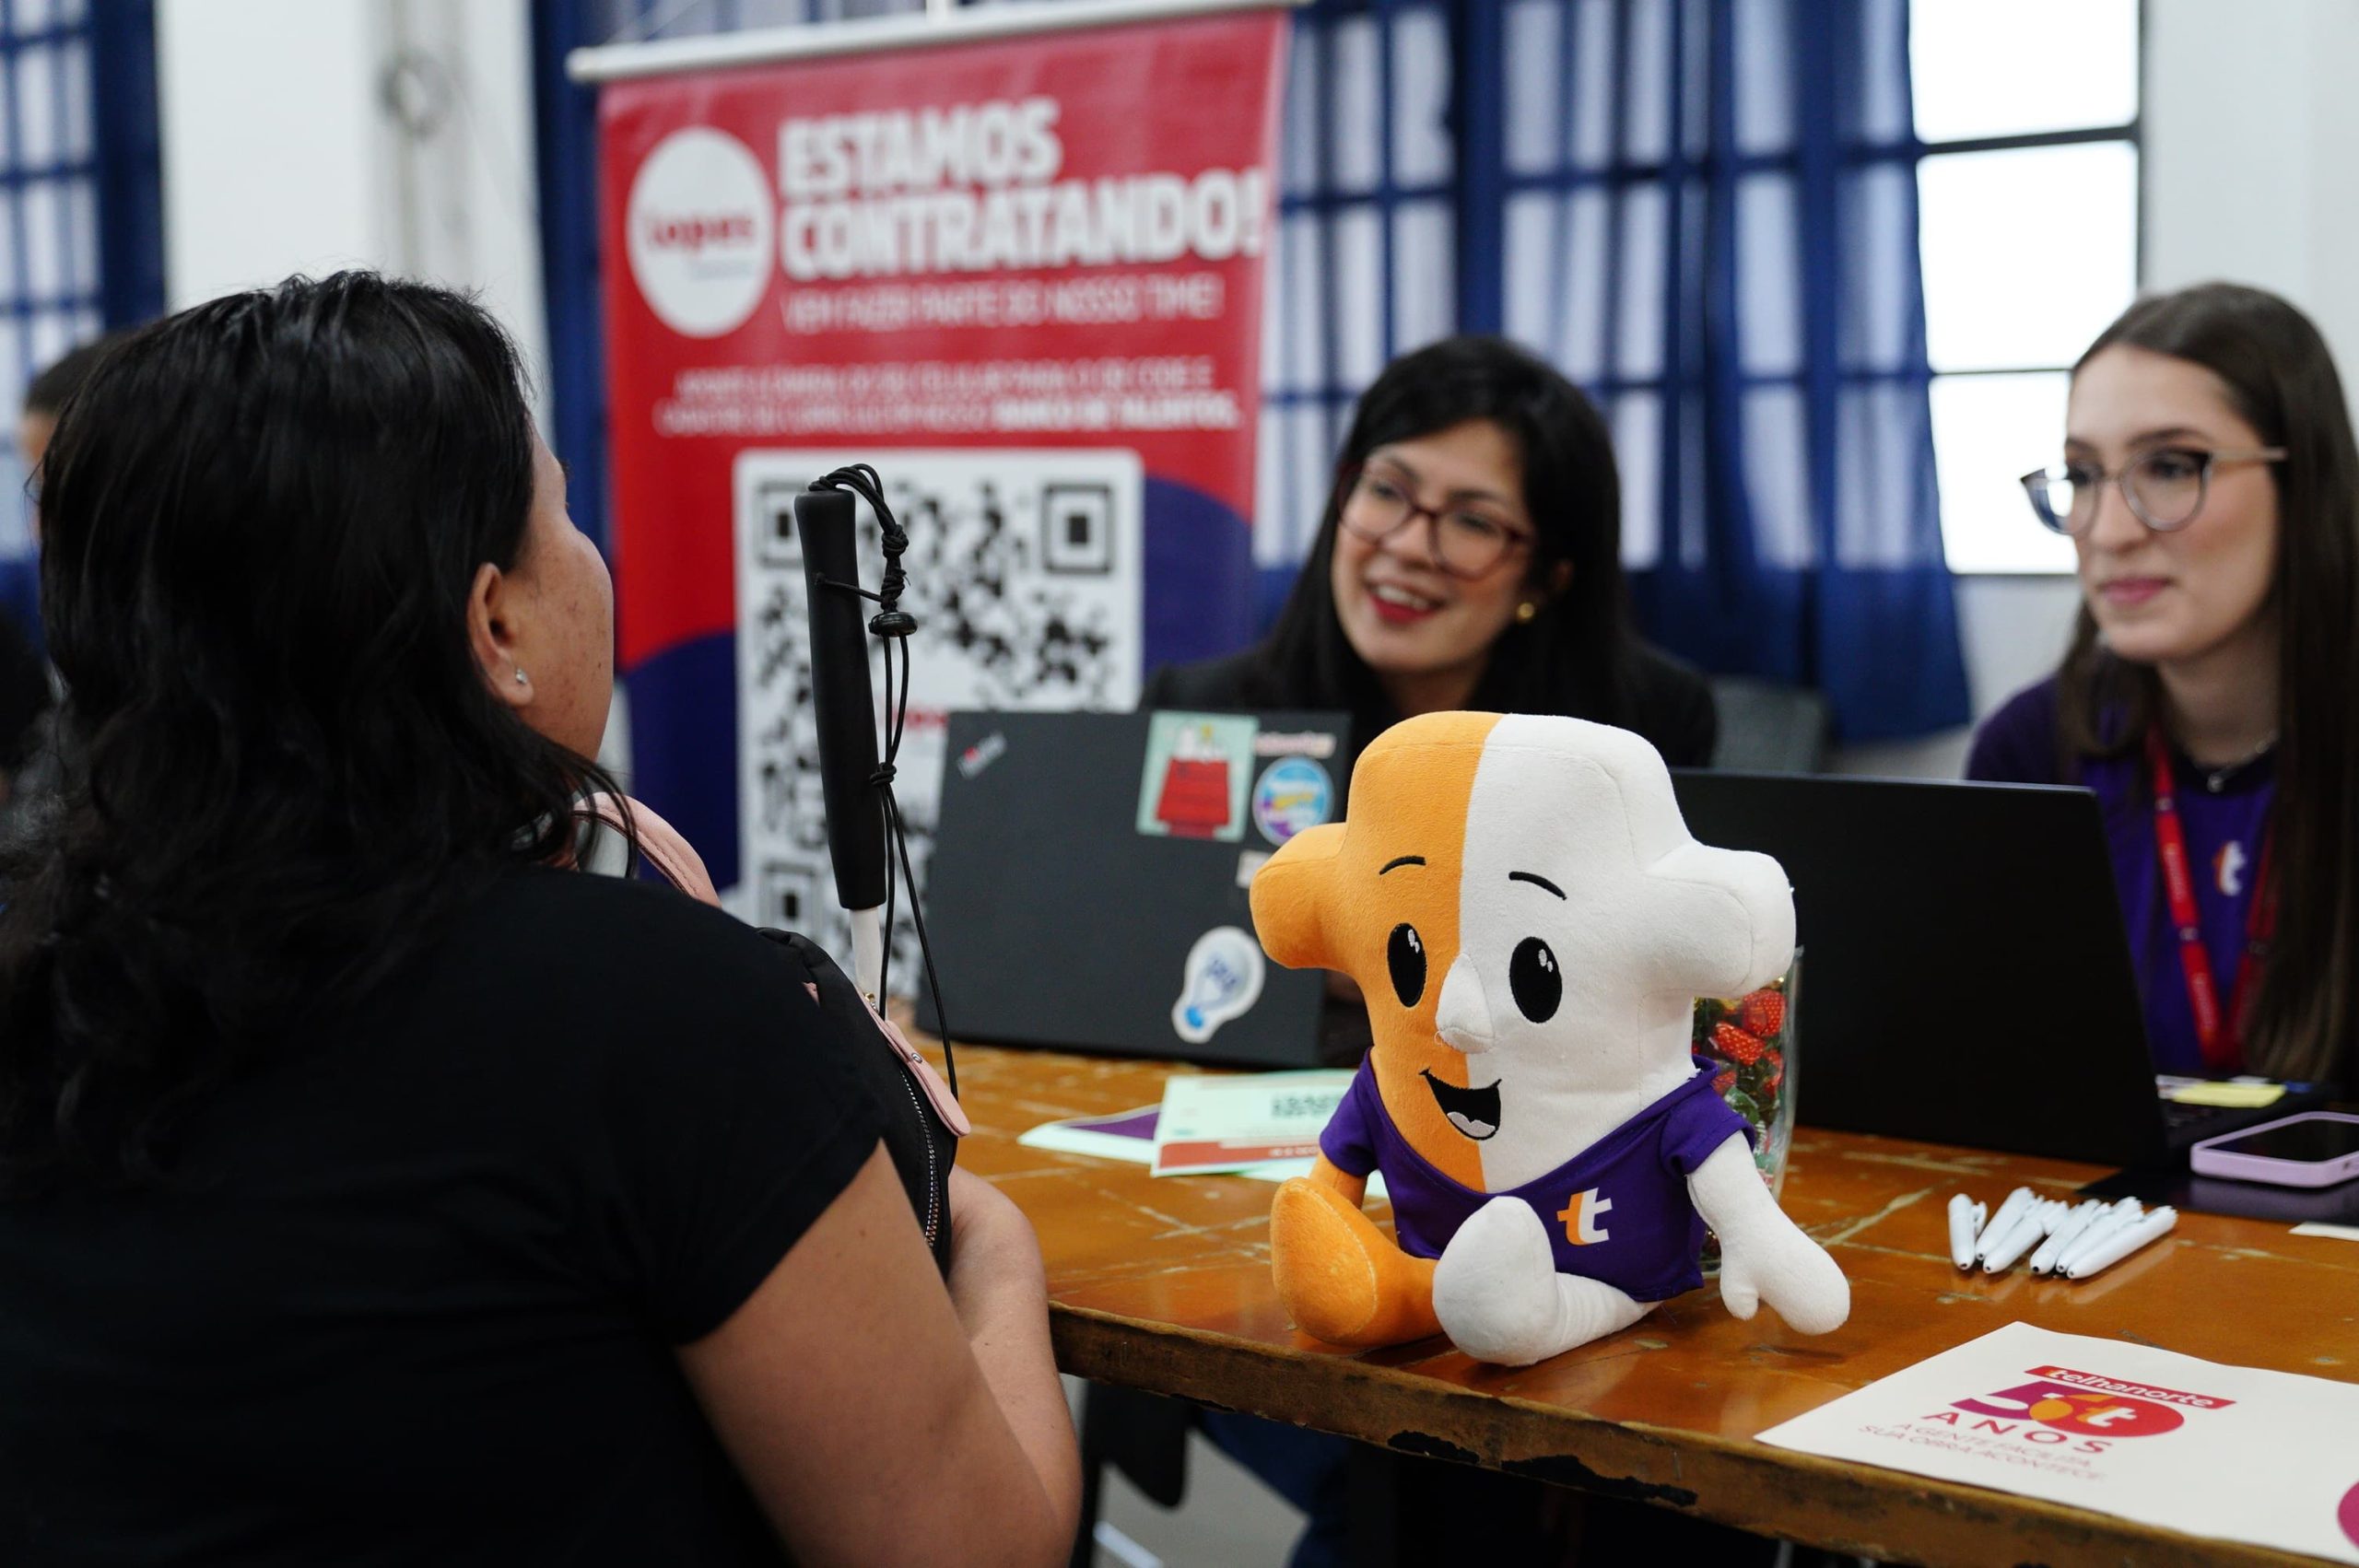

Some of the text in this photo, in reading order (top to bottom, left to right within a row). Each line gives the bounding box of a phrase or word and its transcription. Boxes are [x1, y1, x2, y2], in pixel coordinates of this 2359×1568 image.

[780, 97, 1062, 202] ESTAMOS
[781, 168, 1266, 279] CONTRATANDO!
[840, 287, 914, 329] FAZER
[917, 285, 1001, 326] PARTE
[1049, 279, 1141, 321] NOSSO
[1145, 275, 1222, 317] TIME!
[1556, 1187, 1613, 1246] t
[2046, 1367, 2215, 1408] telhanorte
[1920, 1411, 2113, 1455] ANOS
